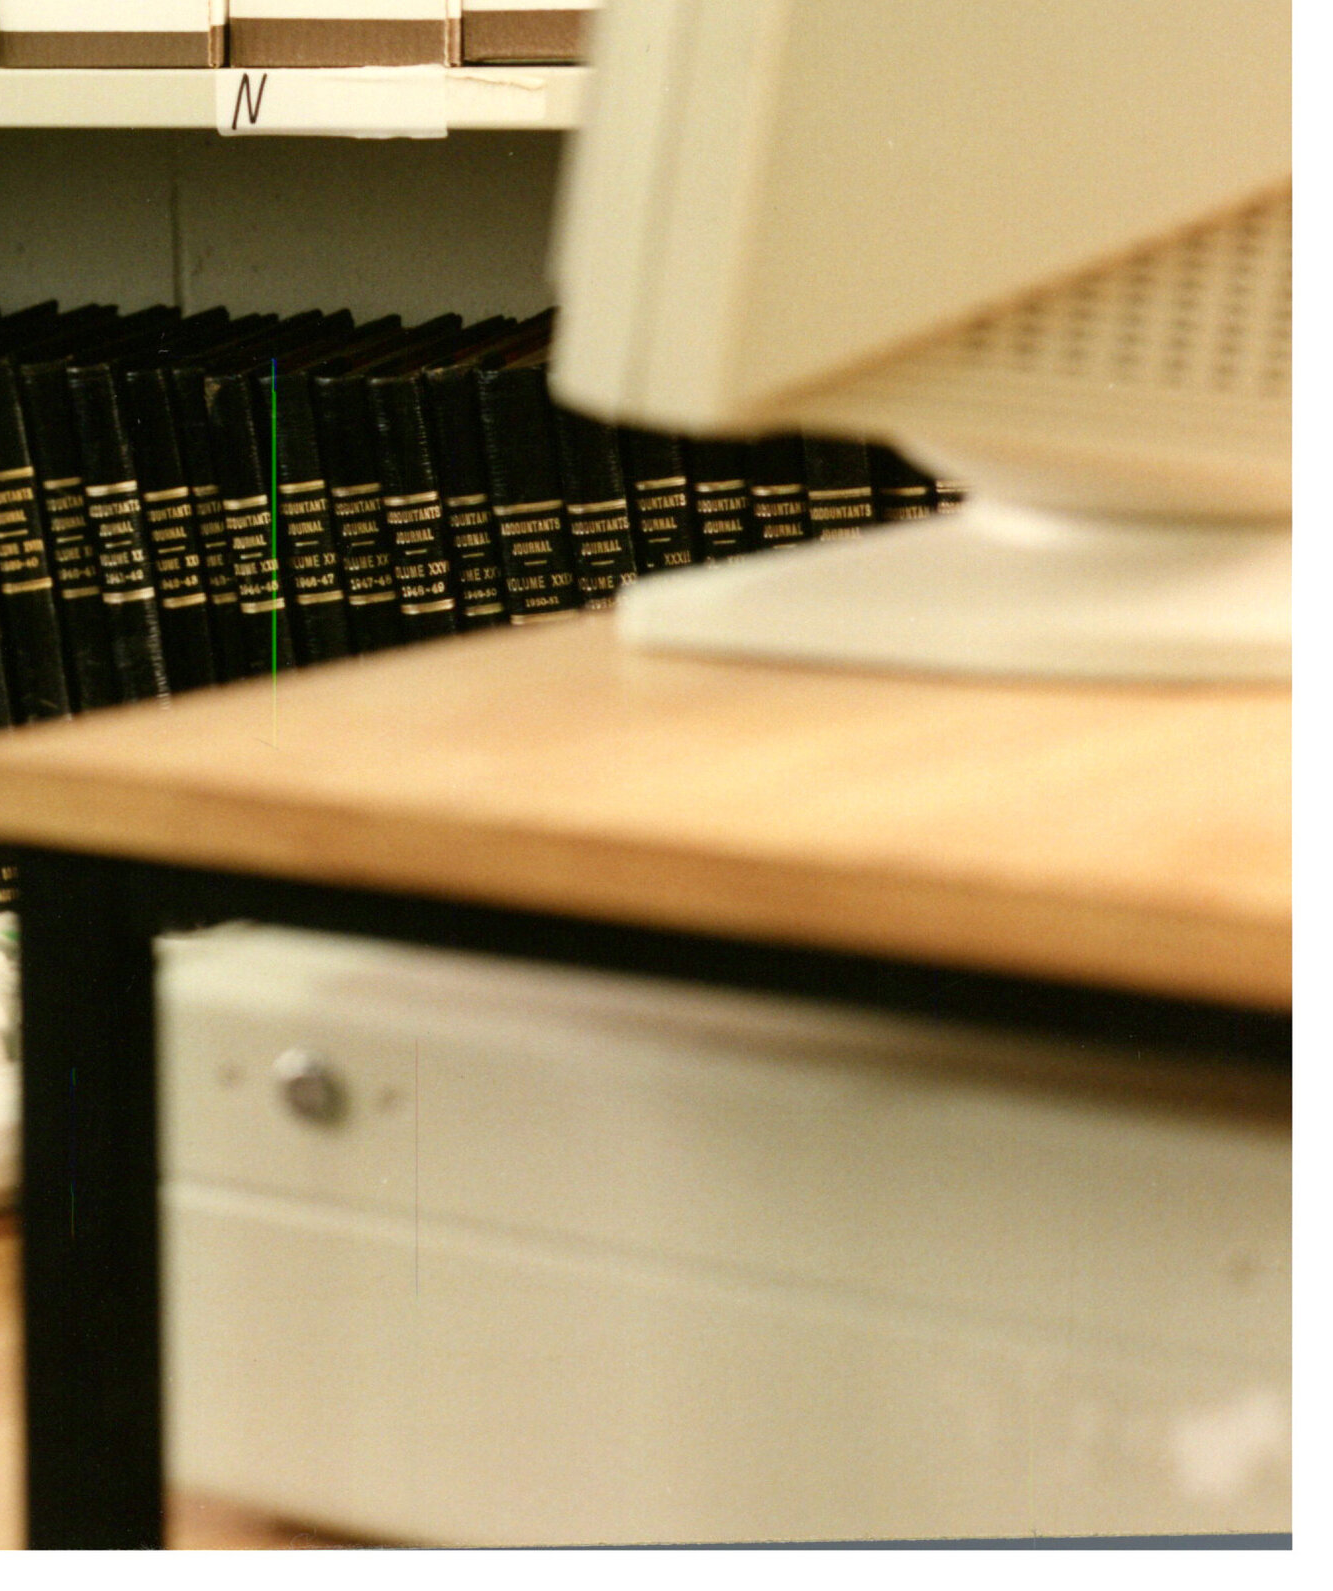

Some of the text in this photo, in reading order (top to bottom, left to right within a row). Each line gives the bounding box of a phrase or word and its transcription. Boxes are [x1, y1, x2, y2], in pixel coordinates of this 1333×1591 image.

[231, 72, 268, 130] N
[511, 538, 554, 557] JOURNAL
[580, 537, 623, 557] JOURNAL
[505, 574, 547, 592] VOLUME
